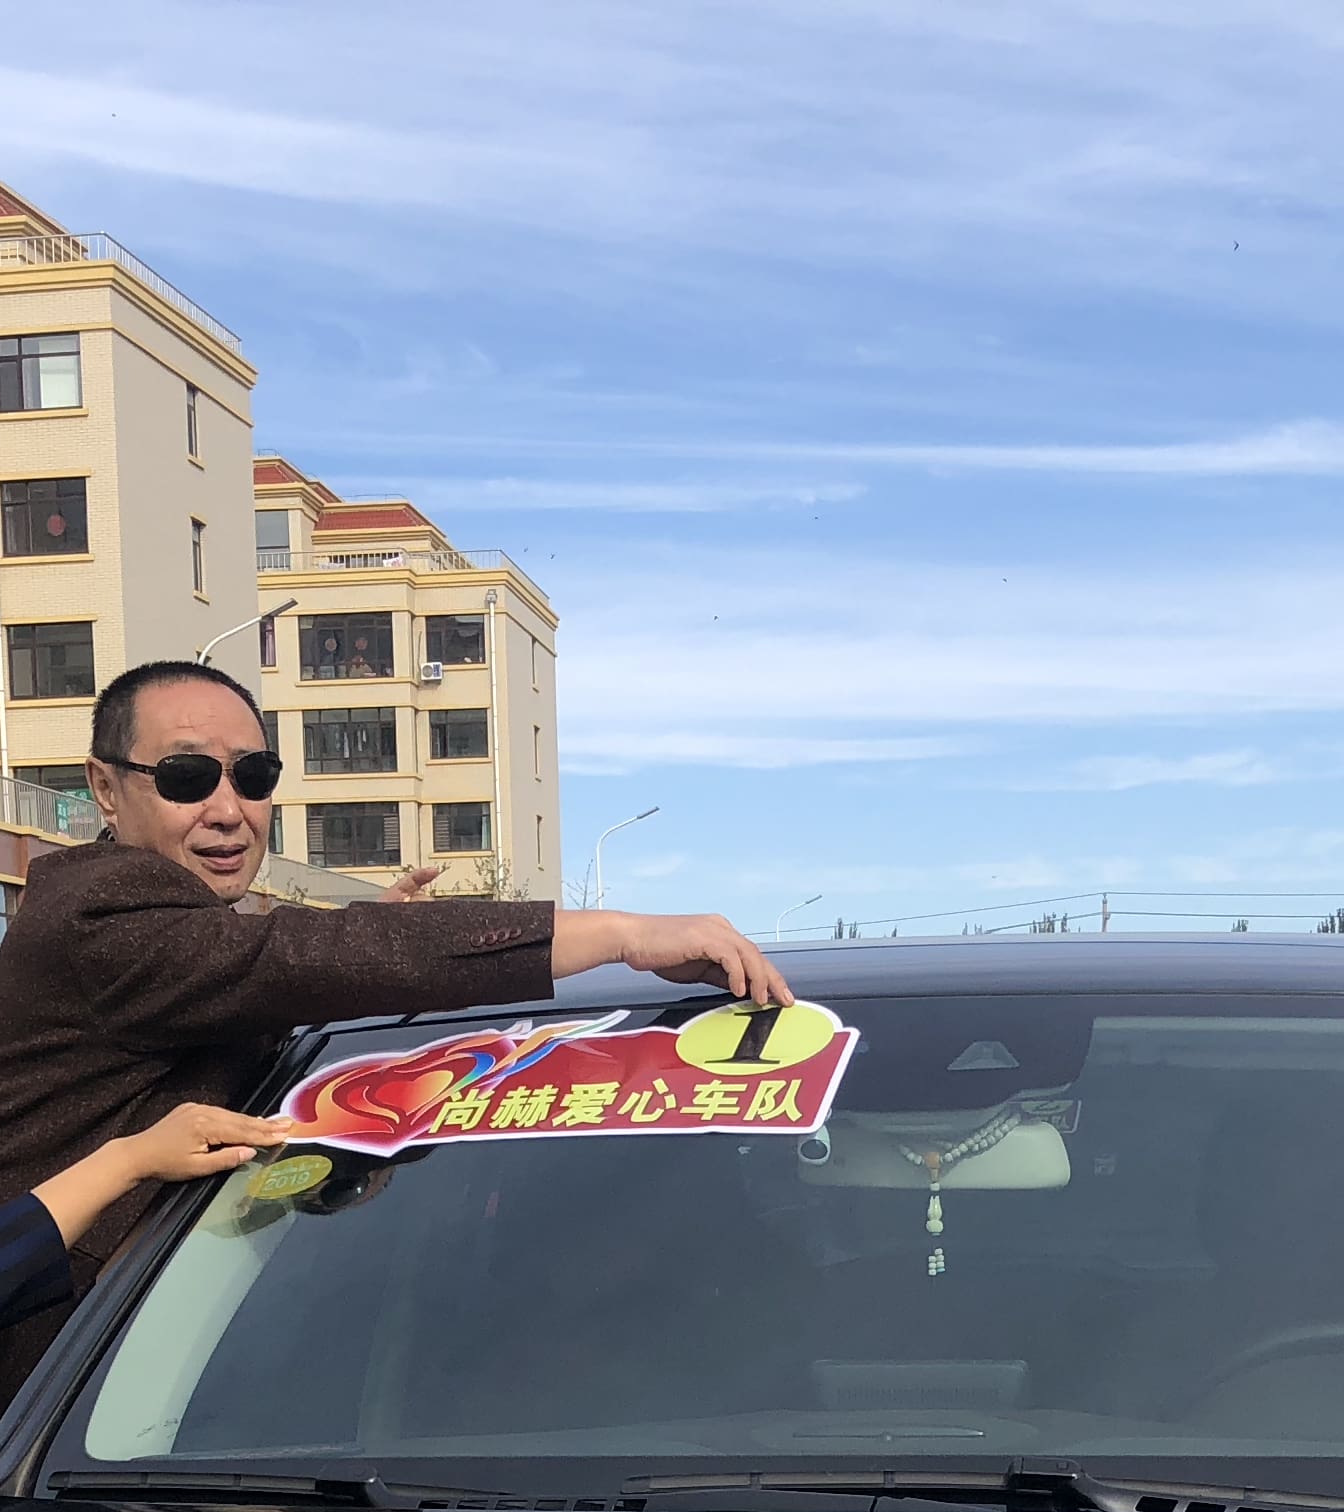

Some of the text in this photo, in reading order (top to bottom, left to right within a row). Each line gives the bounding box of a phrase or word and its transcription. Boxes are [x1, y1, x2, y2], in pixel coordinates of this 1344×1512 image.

[704, 1006, 783, 1065] 1
[429, 1079, 803, 1134] 尚赫爱心车队
[261, 1171, 311, 1191] 2019
